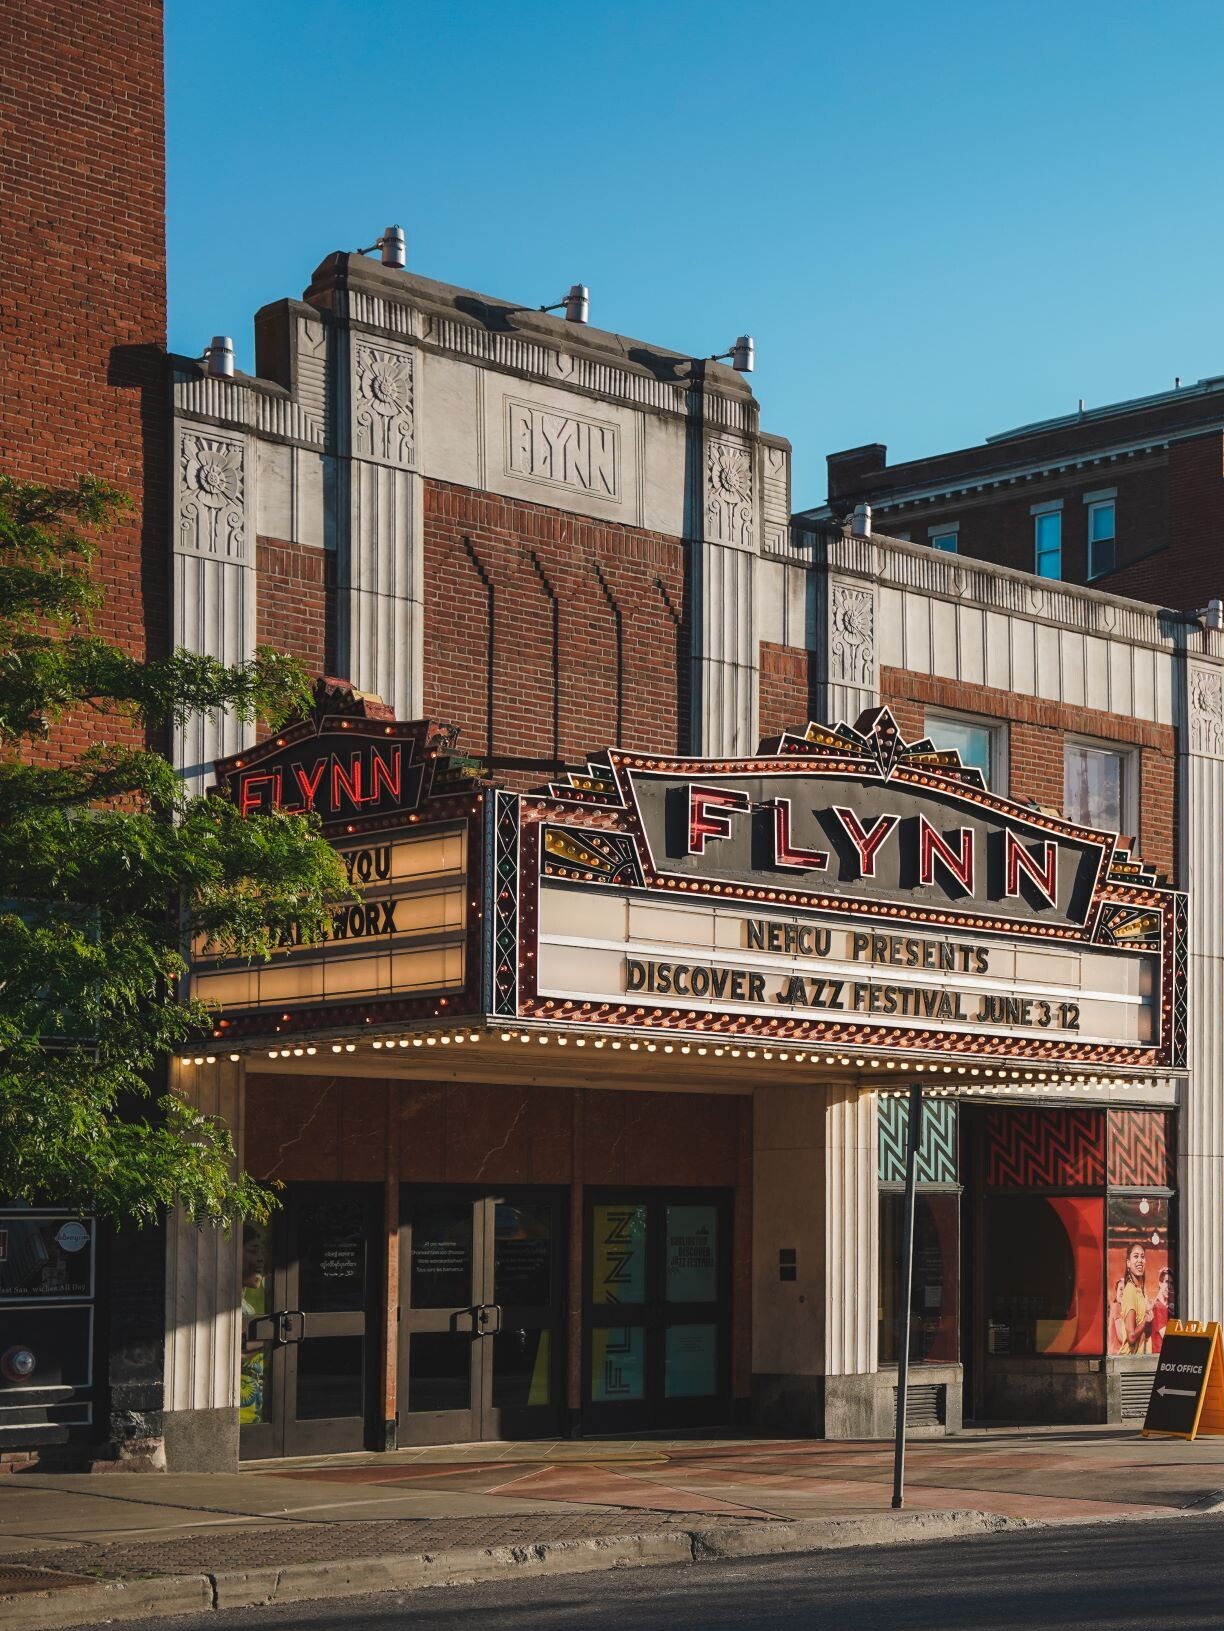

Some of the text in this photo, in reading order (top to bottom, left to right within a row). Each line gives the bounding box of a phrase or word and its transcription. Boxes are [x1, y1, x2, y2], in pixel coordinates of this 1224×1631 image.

[510, 403, 616, 496] FLYNN
[239, 744, 402, 820] FLYNN
[342, 847, 391, 885] YOU
[689, 784, 1059, 910] FLYNN
[747, 919, 990, 974] NEFCU PRESENTS
[628, 959, 766, 1003] DISCOVER
[776, 976, 844, 1009] JAZZ
[854, 982, 967, 1020] FESTIVAL
[976, 995, 1033, 1026] JUNE
[604, 1212, 636, 1395] FLNN
[1160, 1363, 1203, 1374] BOX OFFICE
